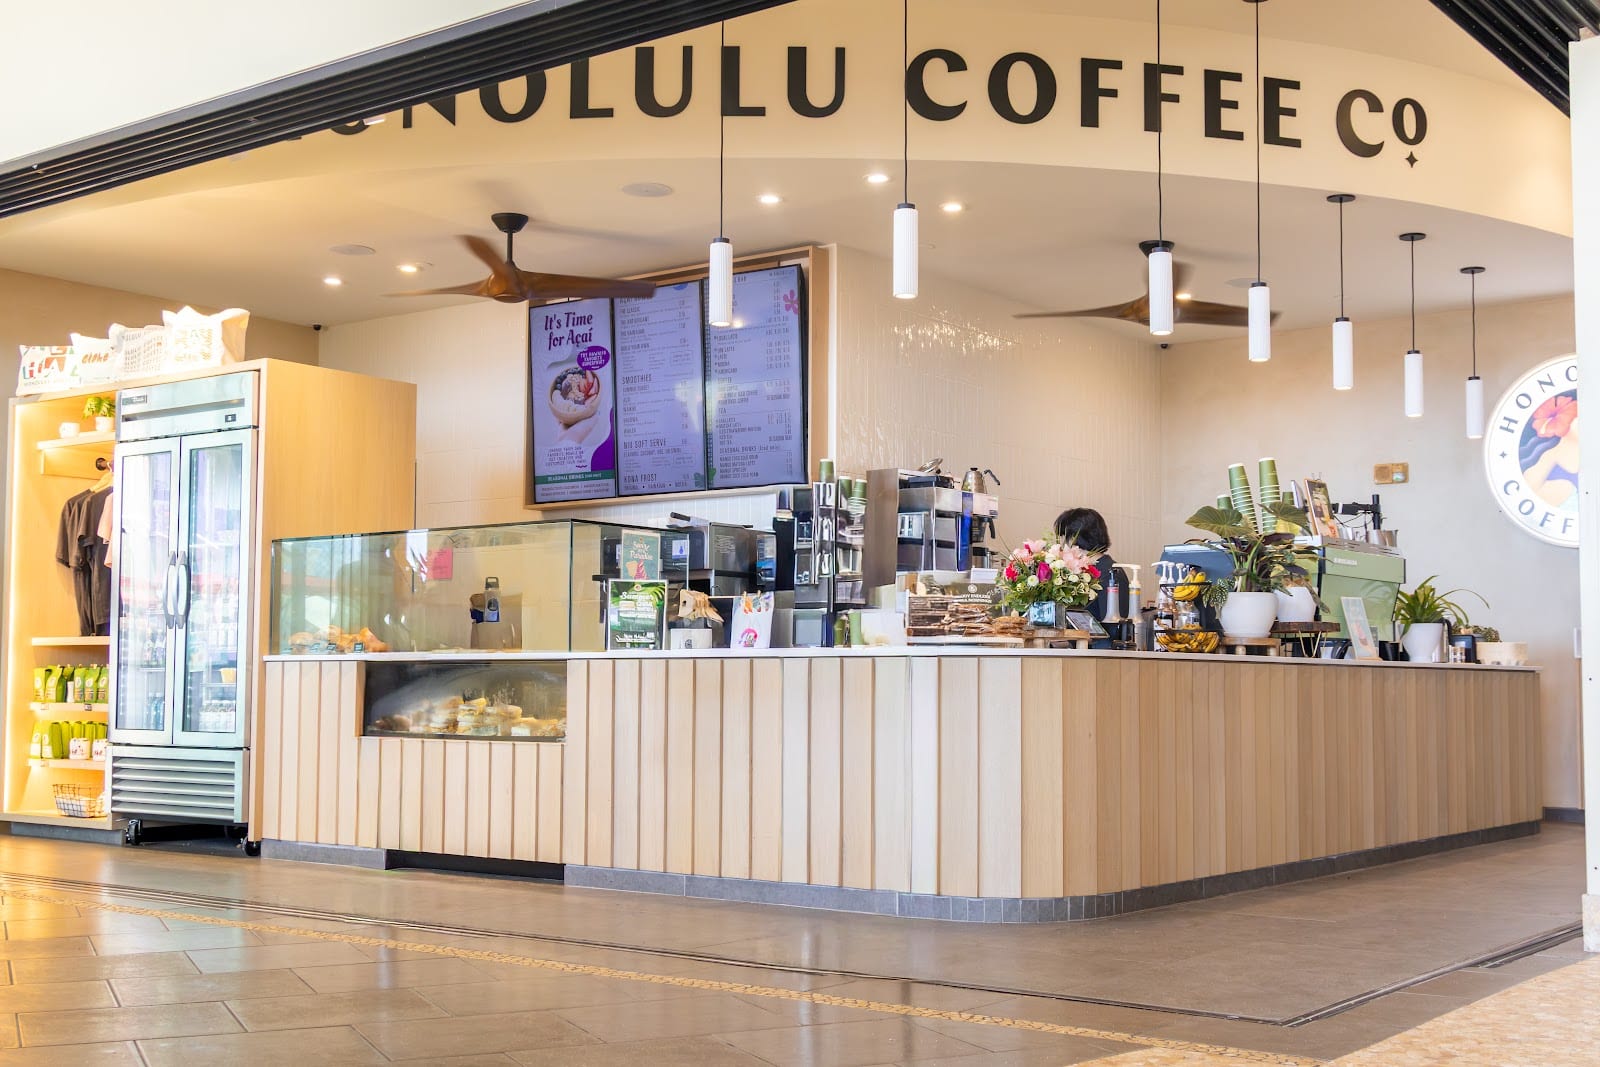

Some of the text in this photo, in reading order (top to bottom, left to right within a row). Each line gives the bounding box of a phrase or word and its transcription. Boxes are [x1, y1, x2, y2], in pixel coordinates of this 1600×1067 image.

[906, 48, 1302, 148] COFFEE
[544, 311, 593, 331] It's Time
[548, 327, 593, 351] for Açaí
